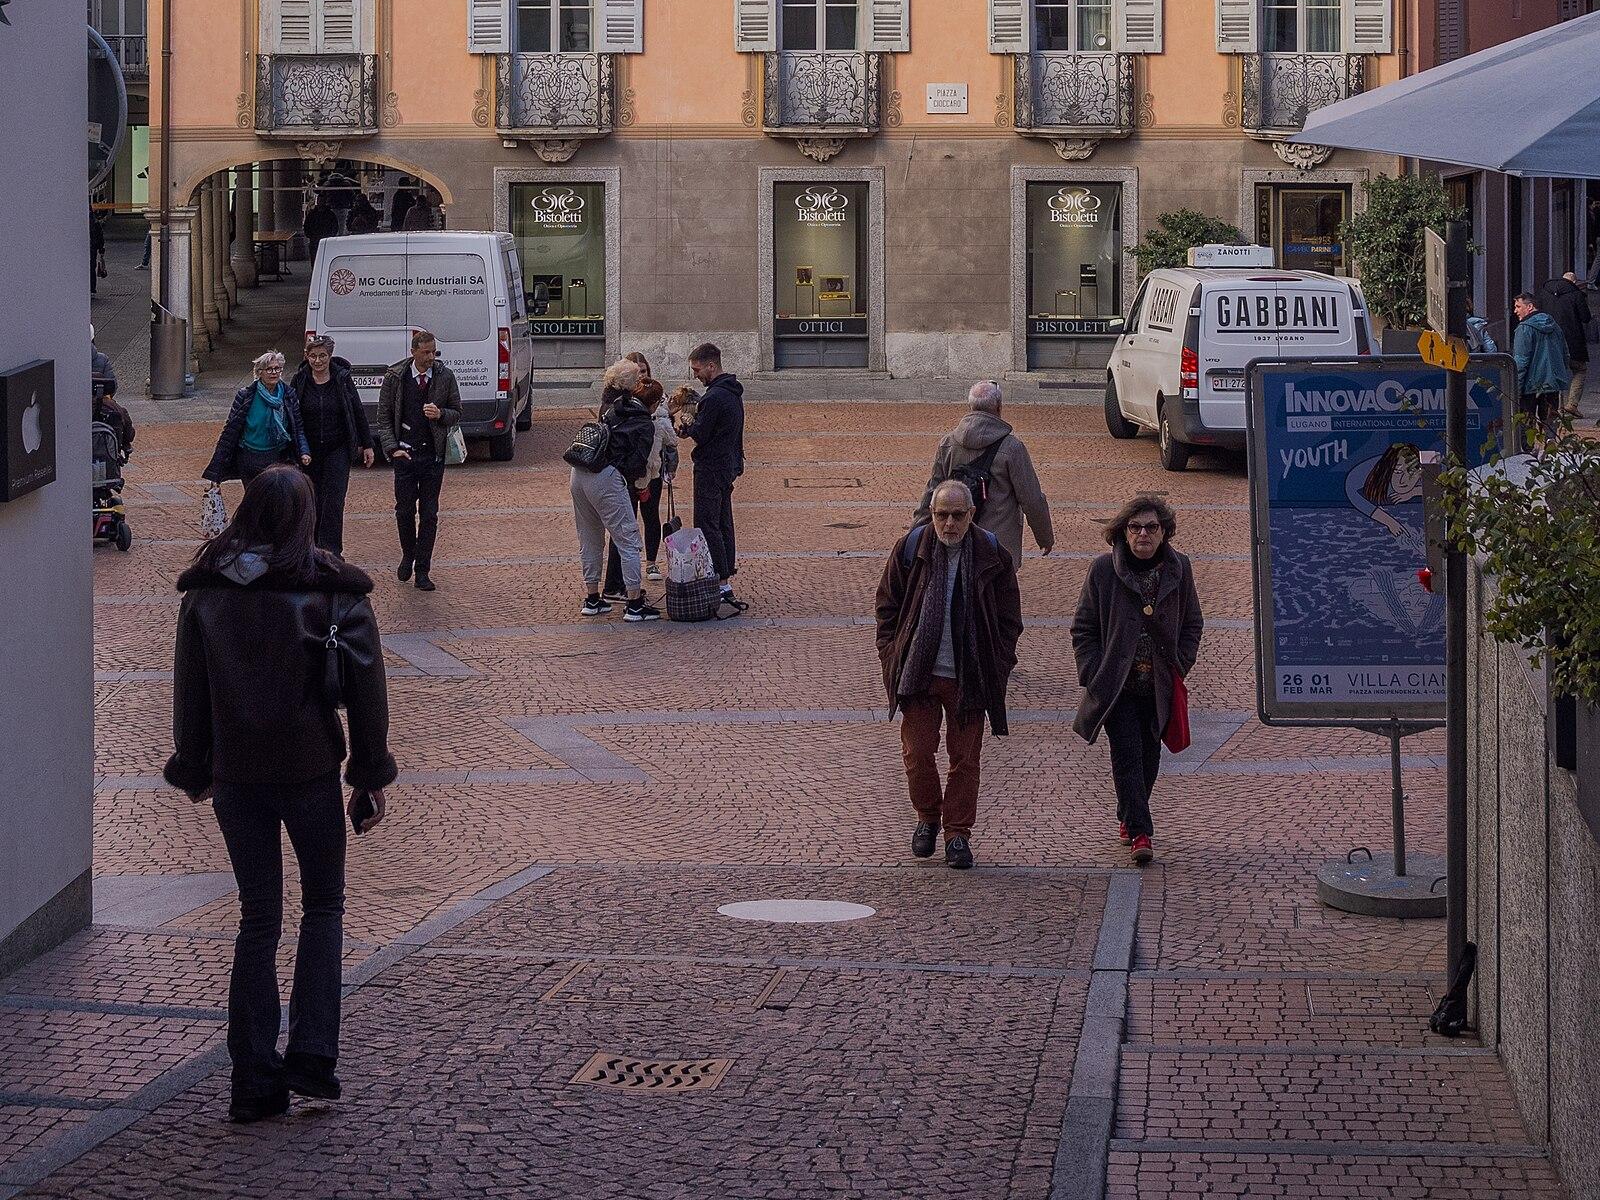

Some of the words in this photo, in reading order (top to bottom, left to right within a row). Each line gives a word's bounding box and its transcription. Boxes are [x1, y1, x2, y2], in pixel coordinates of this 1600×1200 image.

[936, 89, 957, 97] PIAZZA
[534, 210, 582, 223] Bistoletti
[797, 208, 846, 222] Bistoletti
[1050, 209, 1099, 223] Bistoletti
[1260, 194, 1268, 239] CAMBIO
[1217, 248, 1251, 256] ZANOTTI
[358, 277, 375, 286] MG
[378, 277, 414, 286] Cucine
[416, 275, 467, 286] Industriali
[469, 275, 485, 285] SA
[359, 289, 400, 297] Arredamenti
[401, 289, 414, 297] Bar
[419, 288, 447, 298] Alberghi
[452, 288, 485, 296] Ristoranti
[1216, 295, 1339, 327] GABBANI
[530, 322, 598, 334] ISTOLETTI
[799, 321, 844, 332] OTTICI
[1035, 321, 1110, 333] BISTOLETT
[1285, 379, 1479, 413] INNOVACOM
[1290, 420, 1328, 428] LUGANO
[1333, 419, 1396, 428] INTERNATIONAL
[1396, 419, 1420, 428] COMI
[1280, 439, 1348, 479] YOUTH
[1282, 674, 1303, 686] 26
[1311, 674, 1330, 686] 01
[1347, 673, 1402, 687] VILLA
[1283, 686, 1303, 694] FEB
[1309, 686, 1333, 694] MAR
